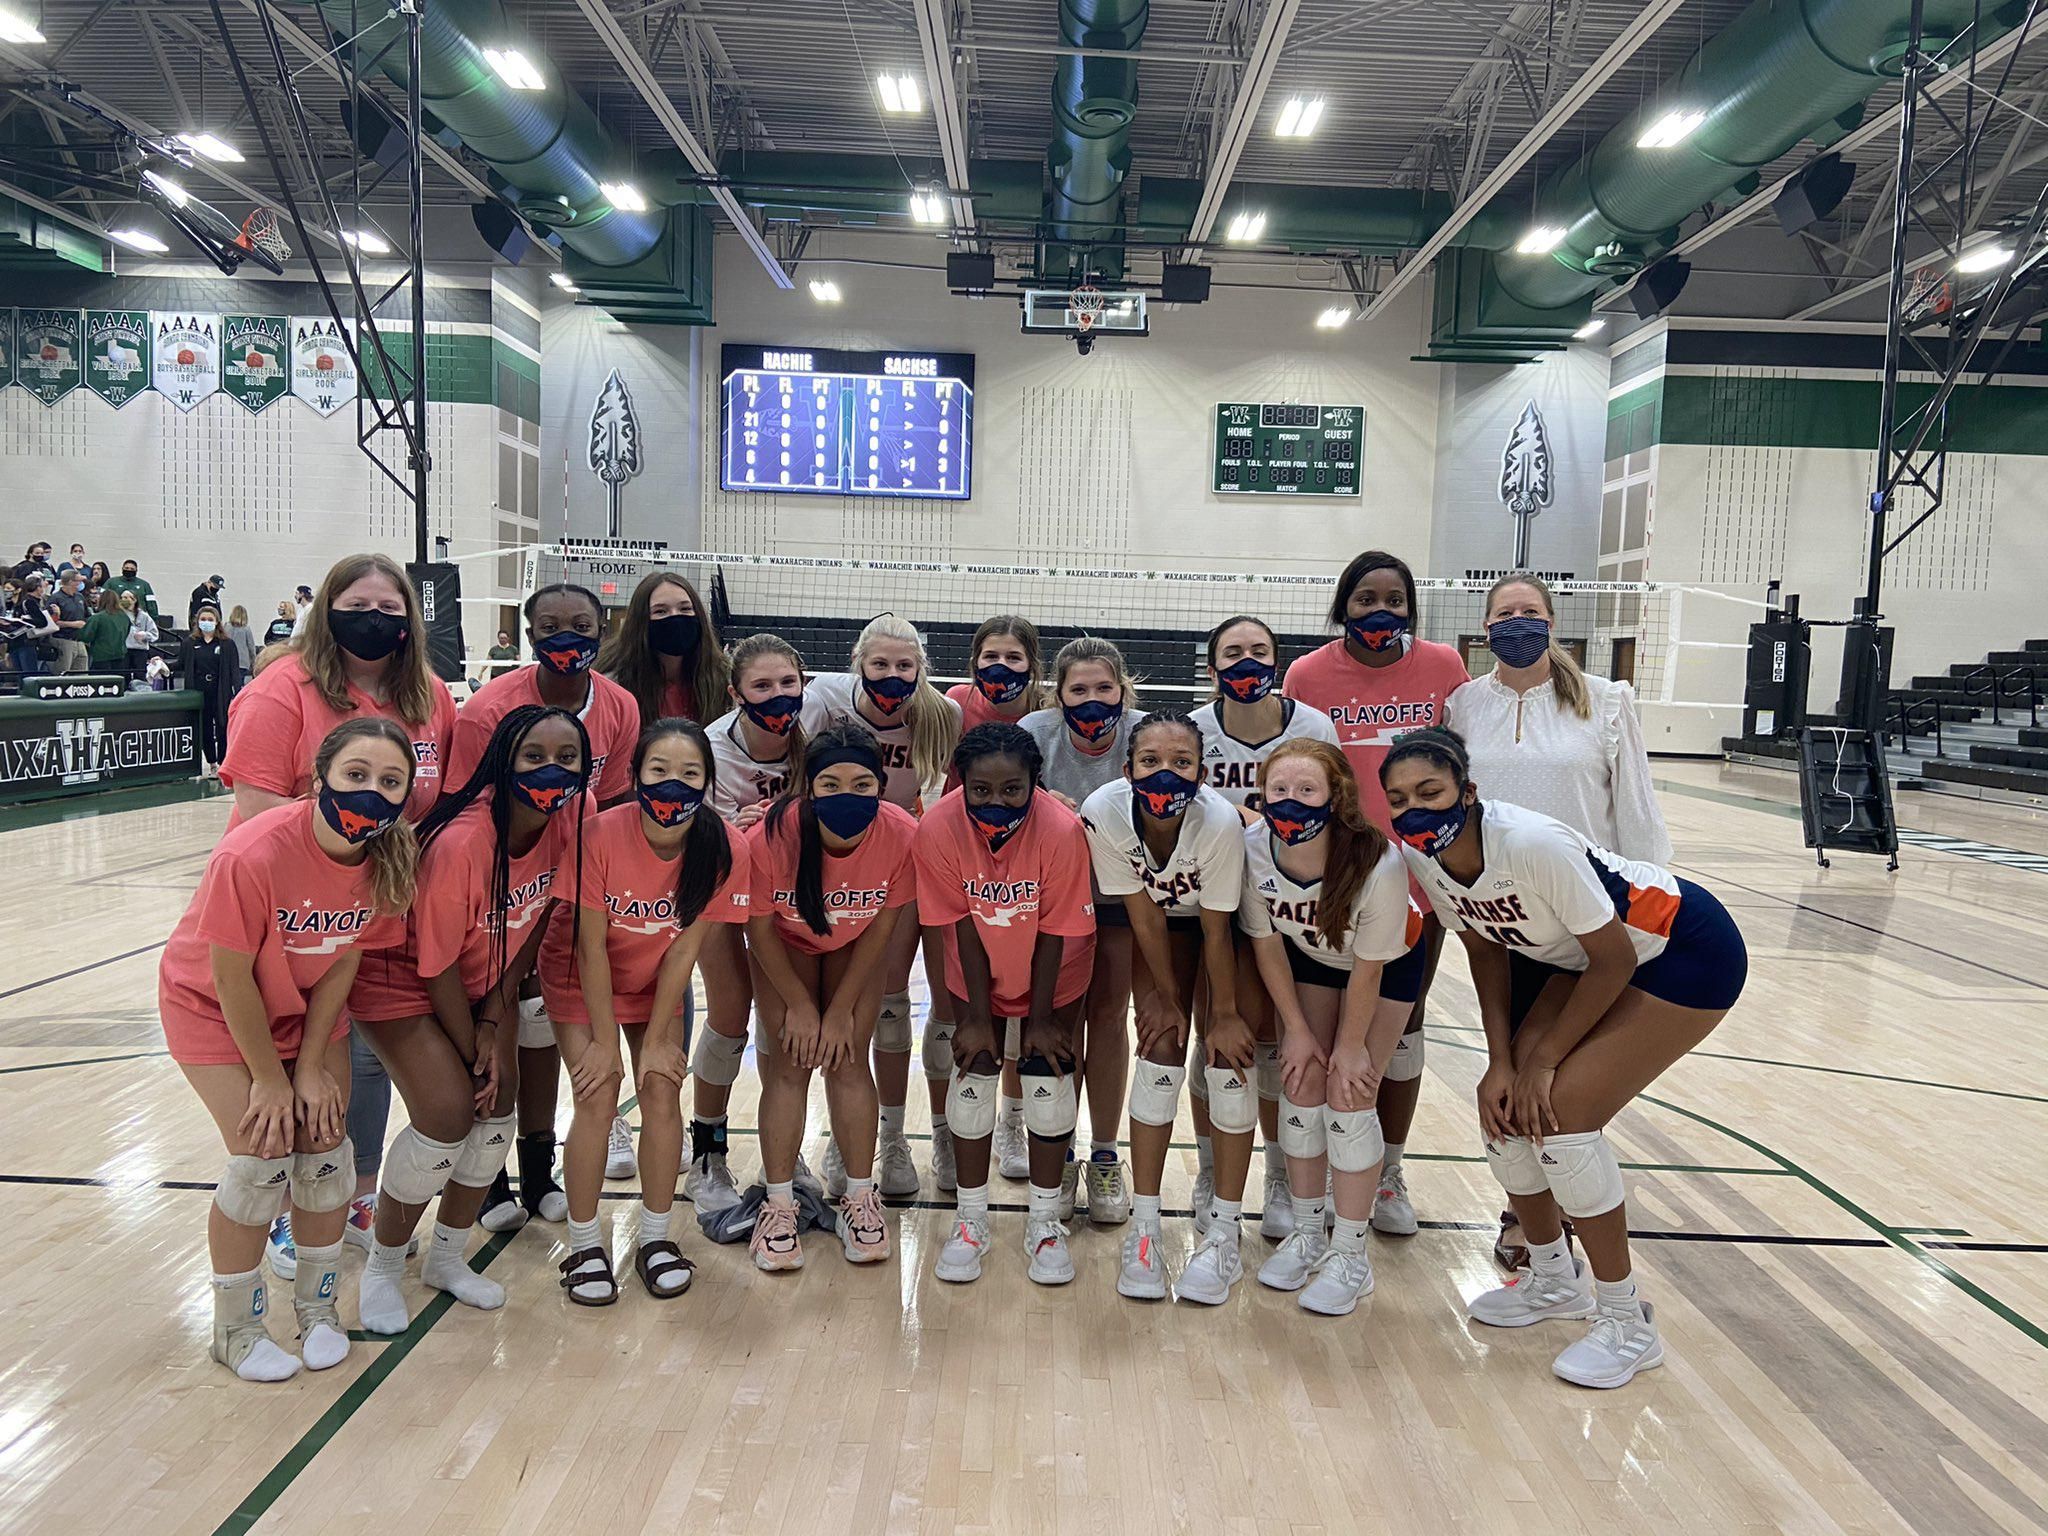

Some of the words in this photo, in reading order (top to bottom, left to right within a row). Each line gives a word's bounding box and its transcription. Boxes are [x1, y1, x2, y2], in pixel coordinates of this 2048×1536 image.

[92, 360, 143, 371] VOLLEYBALL
[157, 363, 173, 372] BOYS
[174, 364, 215, 374] BASKETBALL
[763, 352, 813, 371] HACHIE
[884, 357, 937, 376] SACHSE
[245, 367, 285, 377] BASKETBALL
[314, 369, 354, 379] BASKETBALL
[743, 375, 760, 392] PL
[779, 377, 793, 393] FL
[812, 378, 830, 394] PT
[867, 379, 883, 395] PL
[902, 381, 916, 397] FL
[935, 382, 953, 398] PT
[748, 393, 756, 408] 7
[941, 400, 949, 415] 7
[744, 411, 759, 427] 21
[743, 431, 758, 445] 12
[1227, 427, 1253, 437] HOME
[1278, 433, 1300, 441] PERIOD
[1324, 430, 1353, 439] GUEST
[938, 438, 948, 454] 4
[1221, 459, 1241, 467] FOULS
[1269, 460, 1291, 468] PLAYER
[746, 469, 755, 483] 4
[938, 477, 946, 491] 1
[1220, 483, 1240, 491] SCORE
[1334, 486, 1353, 494] SCORE
[570, 548, 614, 557] WAXAHACHIE
[616, 549, 644, 558] INDIANS
[670, 553, 713, 561] WAXAHACHIE
[715, 555, 743, 563] INDIANS
[770, 557, 813, 566] WAXAHACHIE
[815, 559, 842, 568] INDIANS
[869, 562, 912, 571] WAXAHACHIE
[914, 564, 941, 572] INDIANS
[967, 566, 1011, 575] WAXAHACHIE
[1012, 567, 1040, 576] INDIANS
[1065, 569, 1109, 578] WAXAHACHIE
[1110, 570, 1138, 579] INDIANS
[1164, 573, 1208, 581] WAXAHACHIE
[1209, 574, 1237, 582] INDIANS
[1263, 576, 1306, 584] WAXAHACHIE
[1308, 577, 1335, 585] INDIANS
[590, 563, 636, 575] HOME
[1462, 580, 1495, 588] WAXAHAC
[1563, 582, 1606, 590] WAXAHACHIE
[1608, 583, 1638, 591] INDIANS
[72, 686, 88, 697] POSS
[1330, 703, 1434, 725] PLAYOFFS
[1212, 762, 1263, 789] SAC
[773, 889, 887, 908] PLOFFS
[605, 893, 675, 919] PLAYO
[1265, 896, 1318, 927] SACH
[1447, 893, 1529, 923] SACHSE
[277, 907, 372, 934] PLAYOF
[847, 910, 874, 918] 2020
